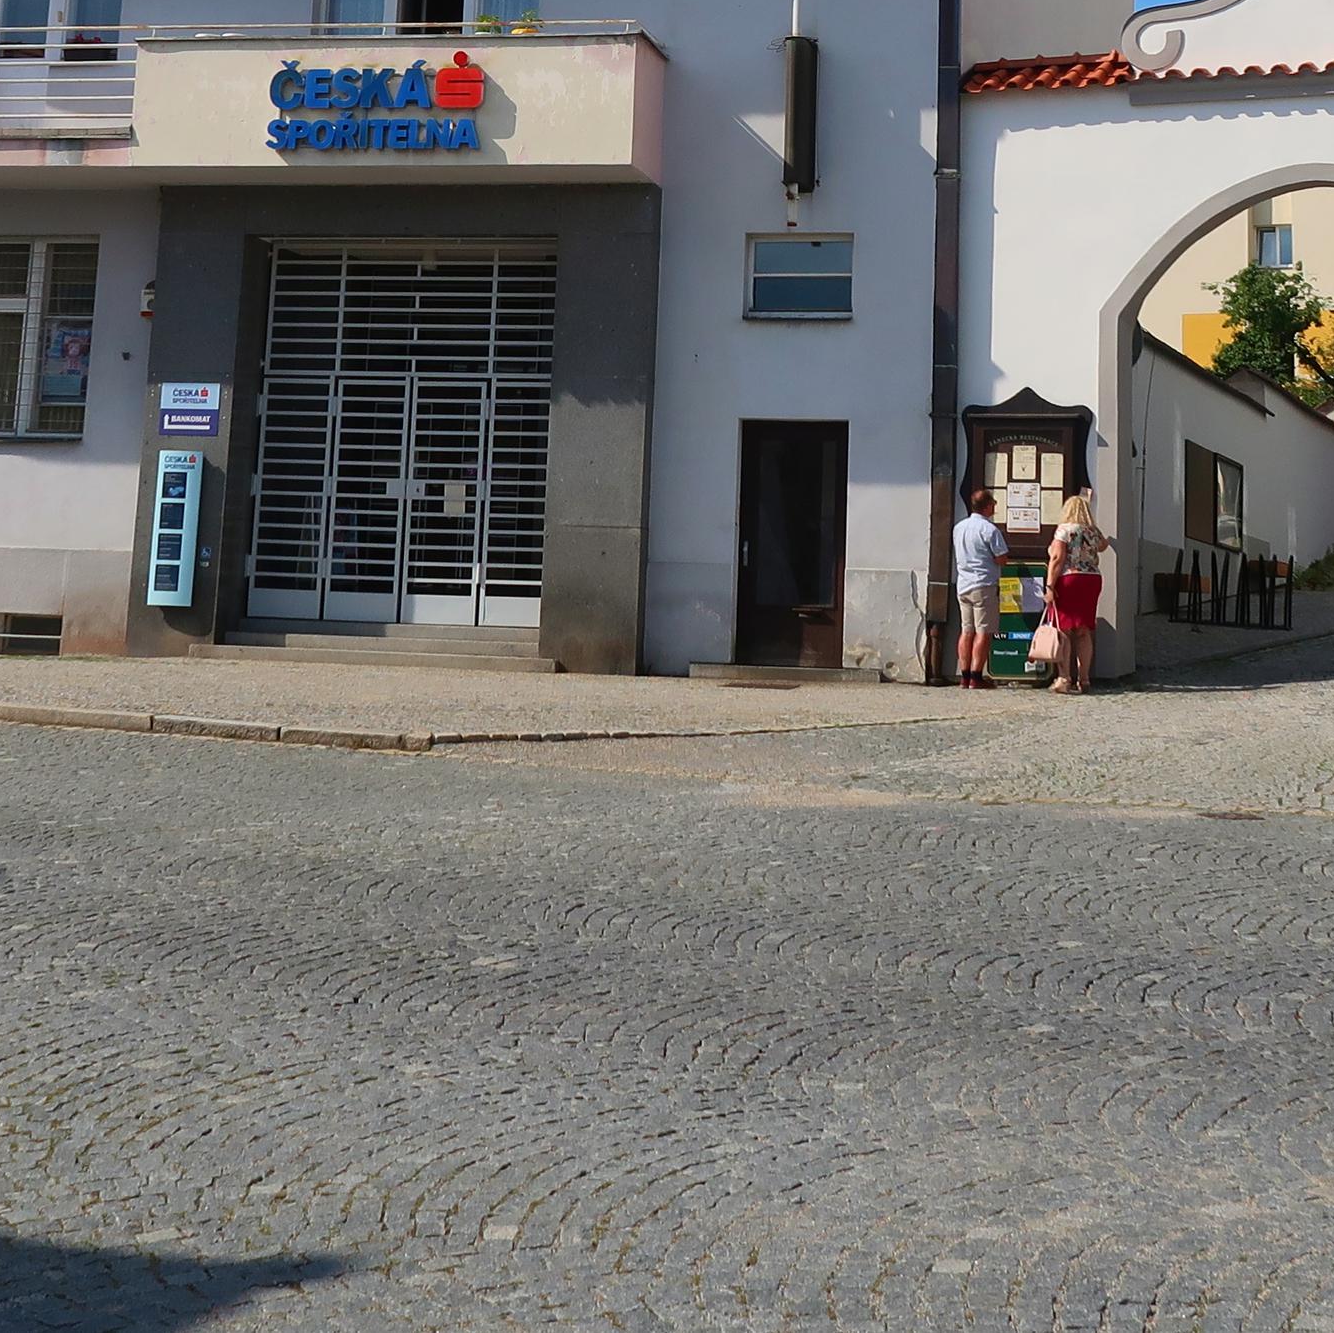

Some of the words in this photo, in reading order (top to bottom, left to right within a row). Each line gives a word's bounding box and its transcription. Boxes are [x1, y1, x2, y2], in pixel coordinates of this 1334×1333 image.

[270, 59, 431, 109] ČESKÁ
[266, 110, 480, 150] SPOŘITELNA
[171, 415, 211, 423] BANKOMAT
